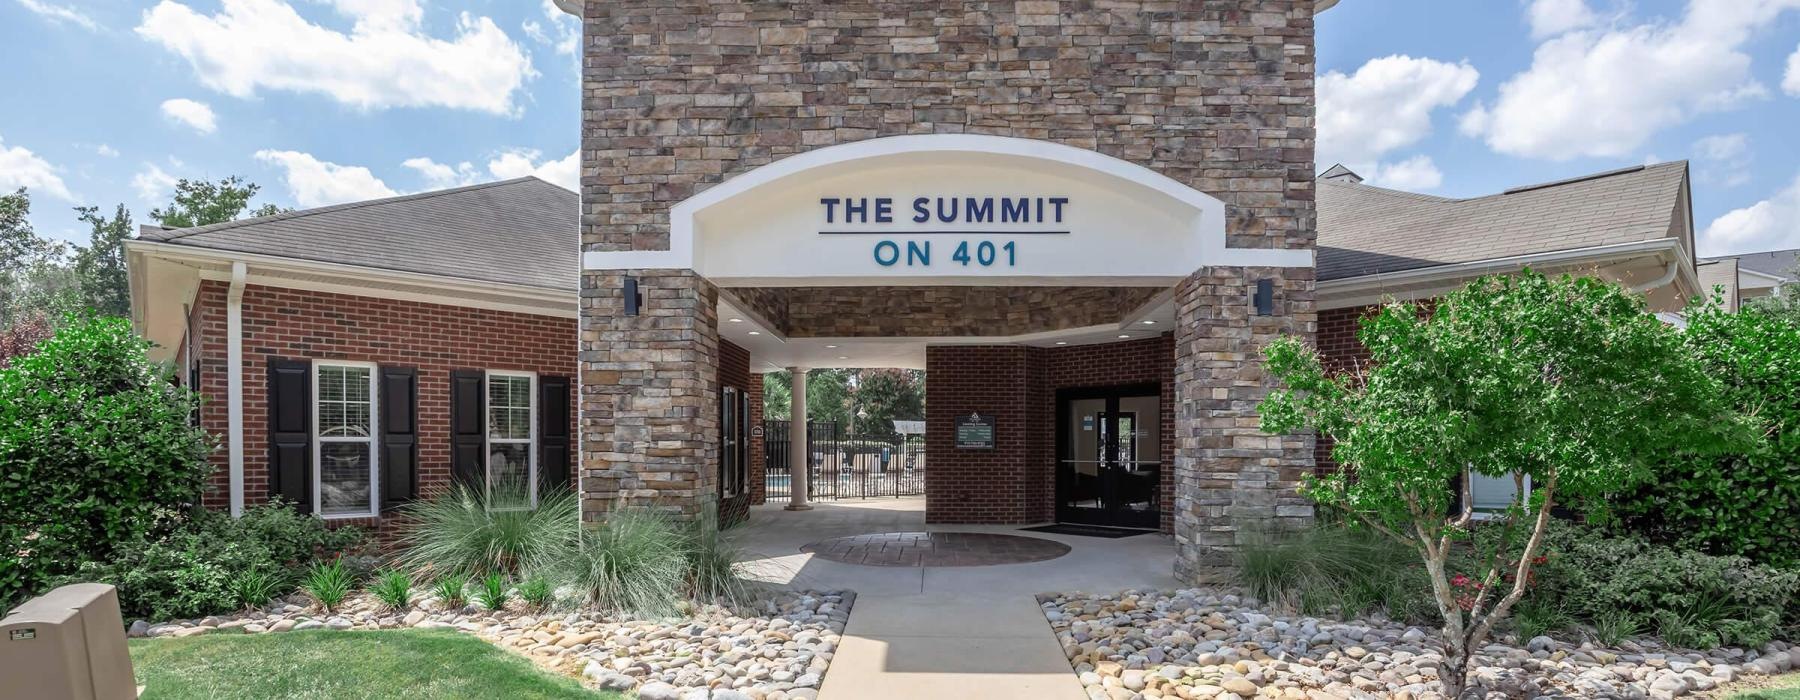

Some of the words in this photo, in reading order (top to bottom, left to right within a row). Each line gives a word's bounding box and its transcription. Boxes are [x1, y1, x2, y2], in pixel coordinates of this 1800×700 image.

[820, 197, 893, 223] THE
[912, 197, 1069, 223] SUMMIT
[873, 240, 930, 267] ON
[952, 240, 1016, 267] 401
